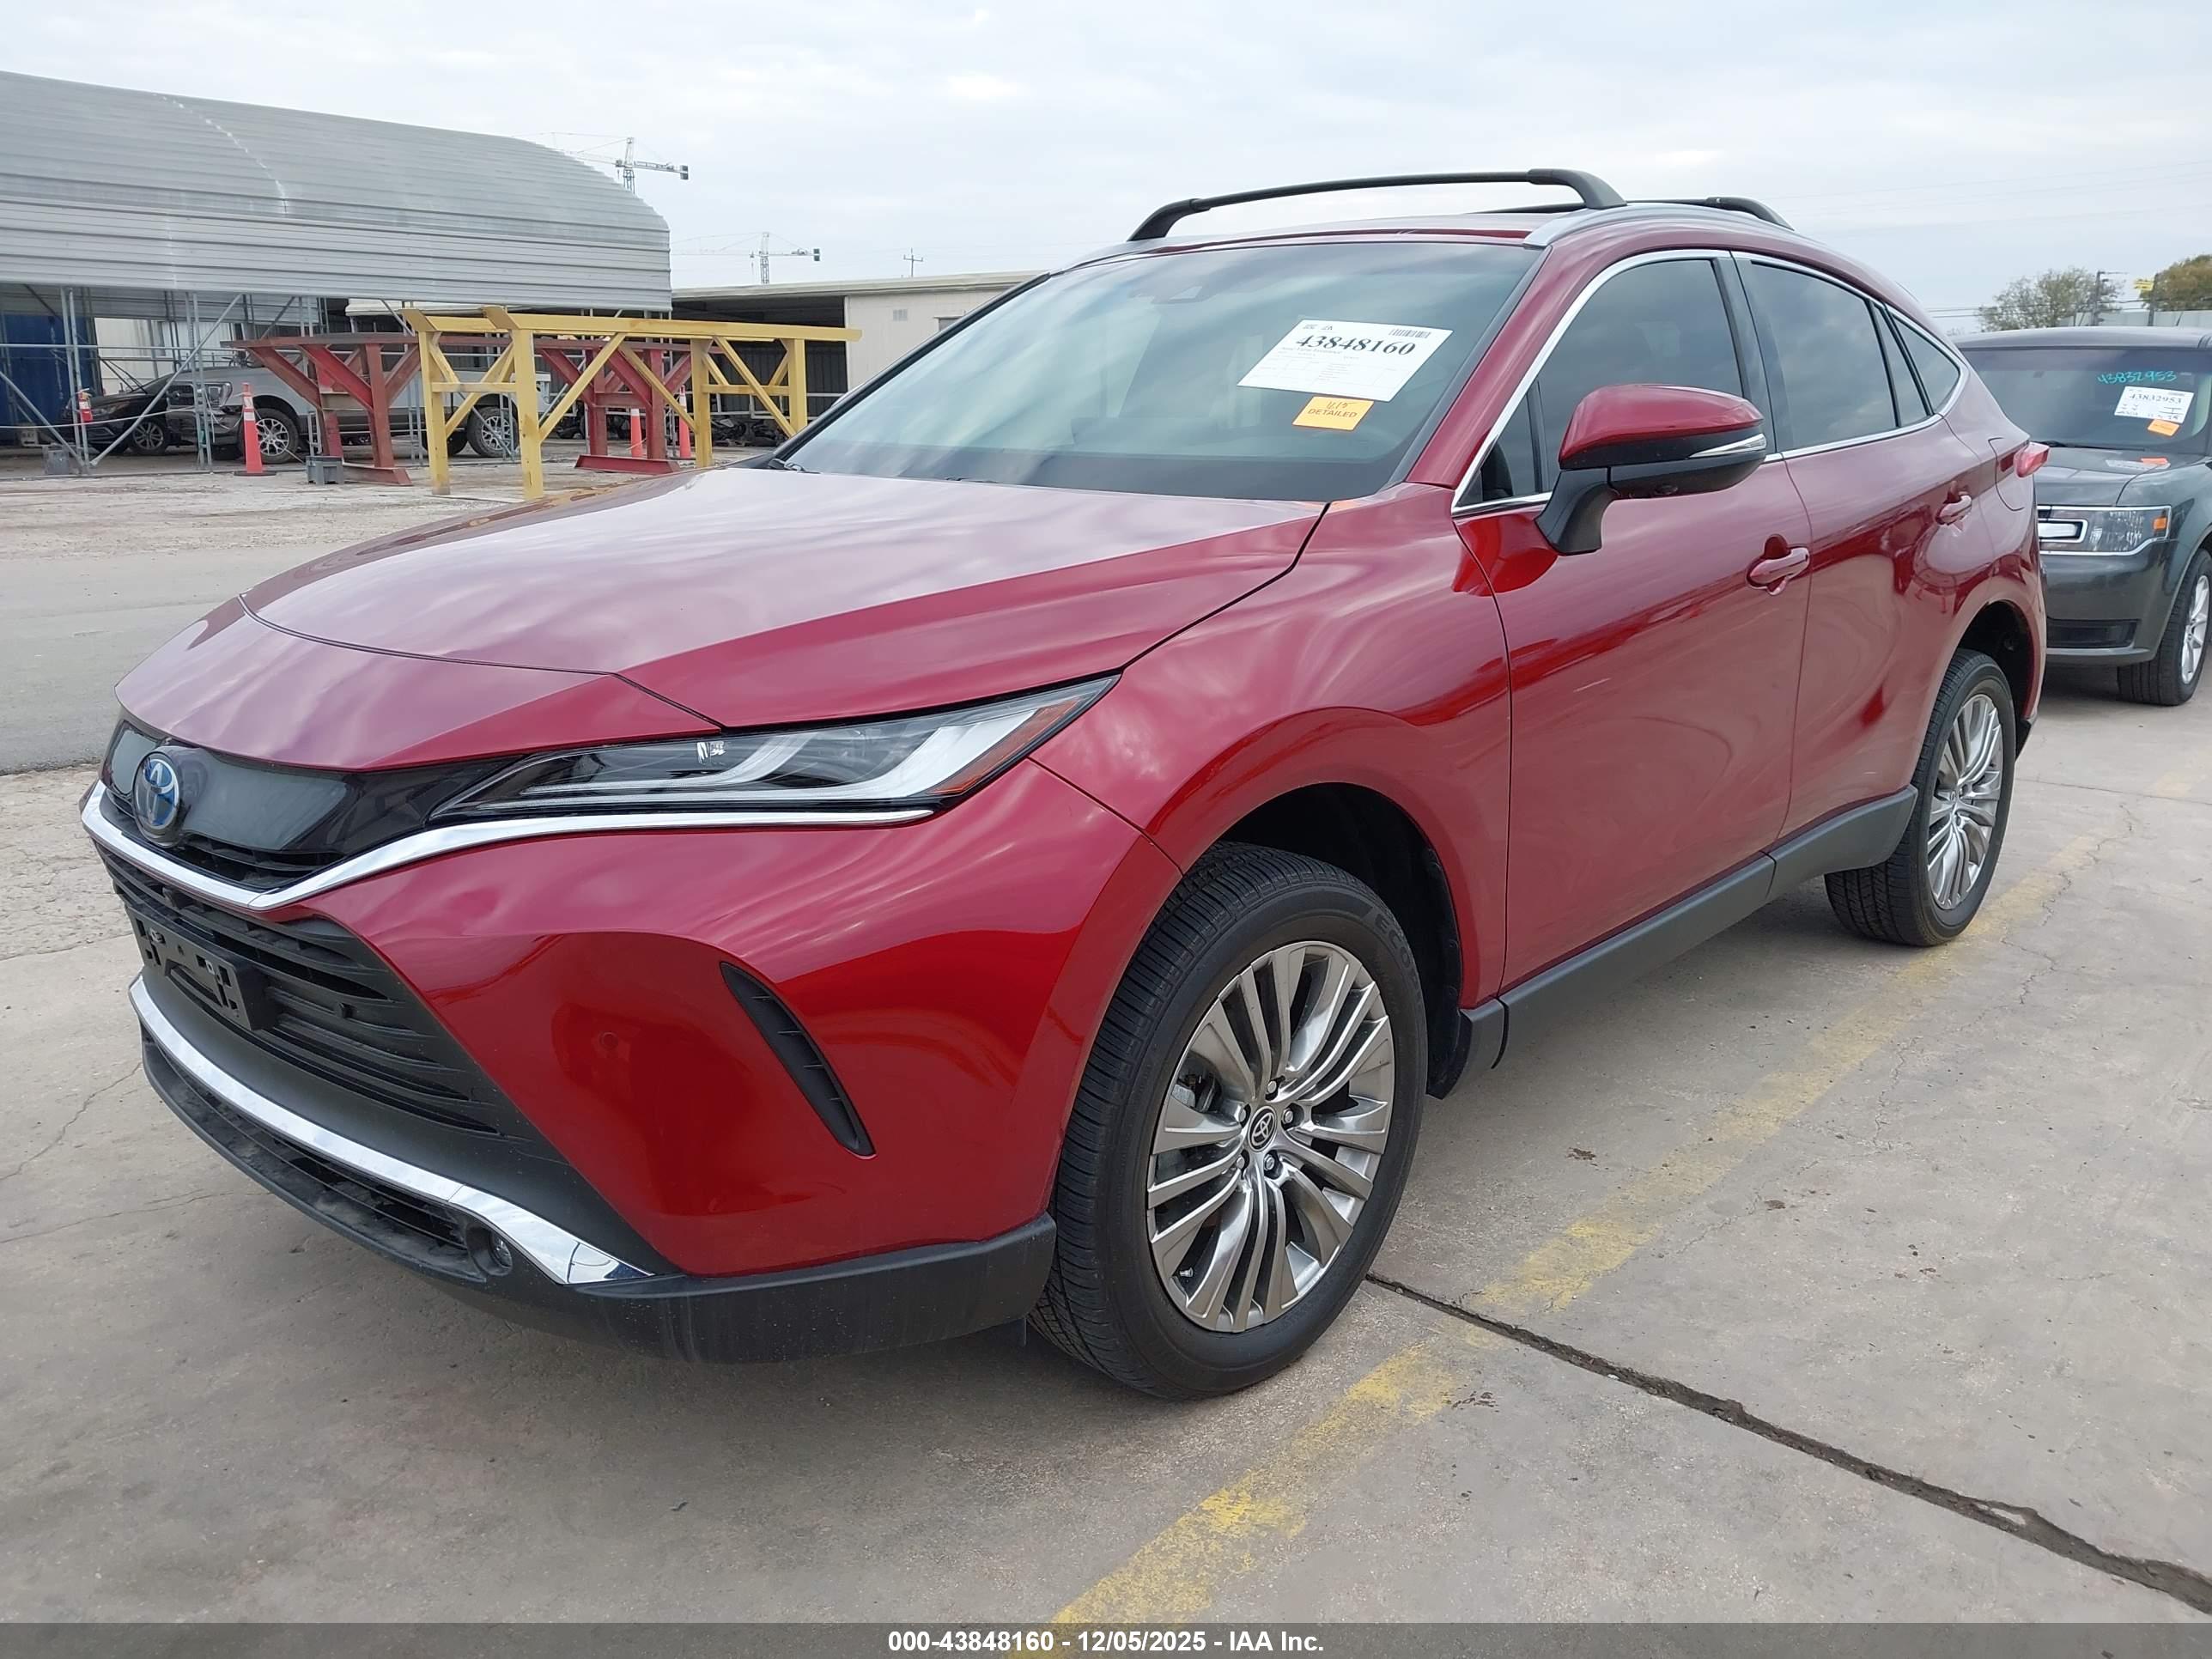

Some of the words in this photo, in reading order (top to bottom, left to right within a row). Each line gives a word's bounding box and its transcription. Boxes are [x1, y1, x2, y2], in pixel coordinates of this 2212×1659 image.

[1296, 334, 1416, 356] 43848160
[2097, 370, 2178, 385] 43832953
[2129, 392, 2182, 404] 43832953
[1308, 408, 1358, 418] DETAILED
